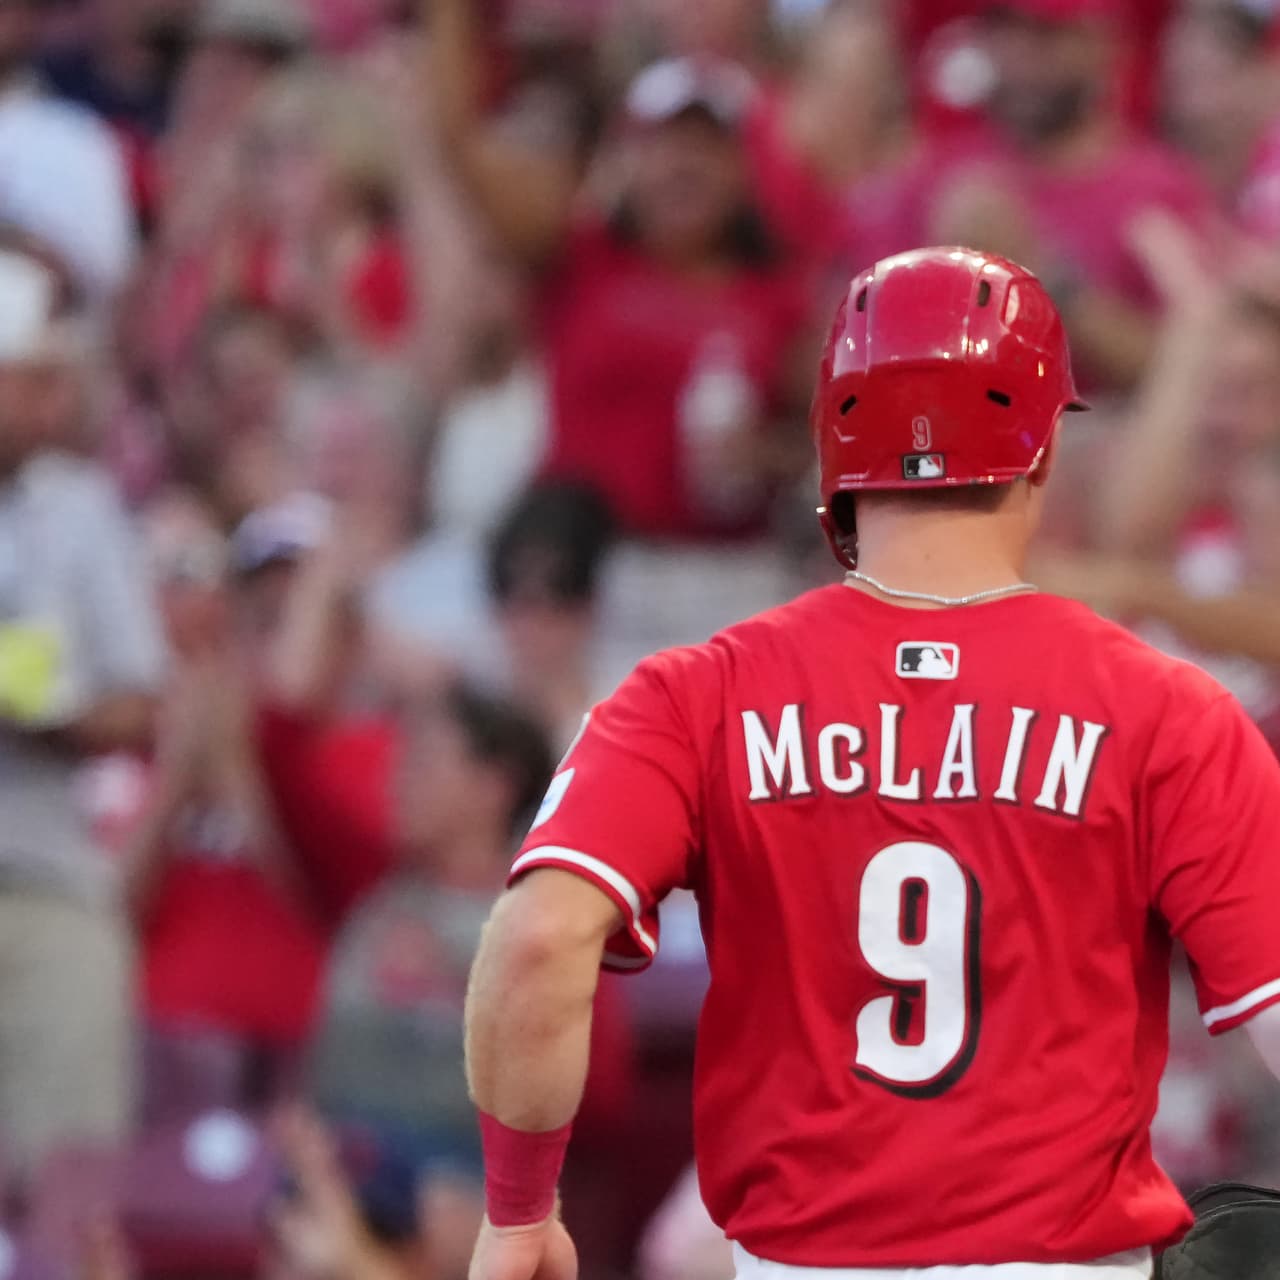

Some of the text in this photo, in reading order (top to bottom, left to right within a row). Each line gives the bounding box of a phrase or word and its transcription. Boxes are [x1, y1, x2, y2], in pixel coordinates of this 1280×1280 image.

[911, 415, 931, 451] 9
[741, 703, 1106, 819] McLAIN
[854, 840, 982, 1099] 9
